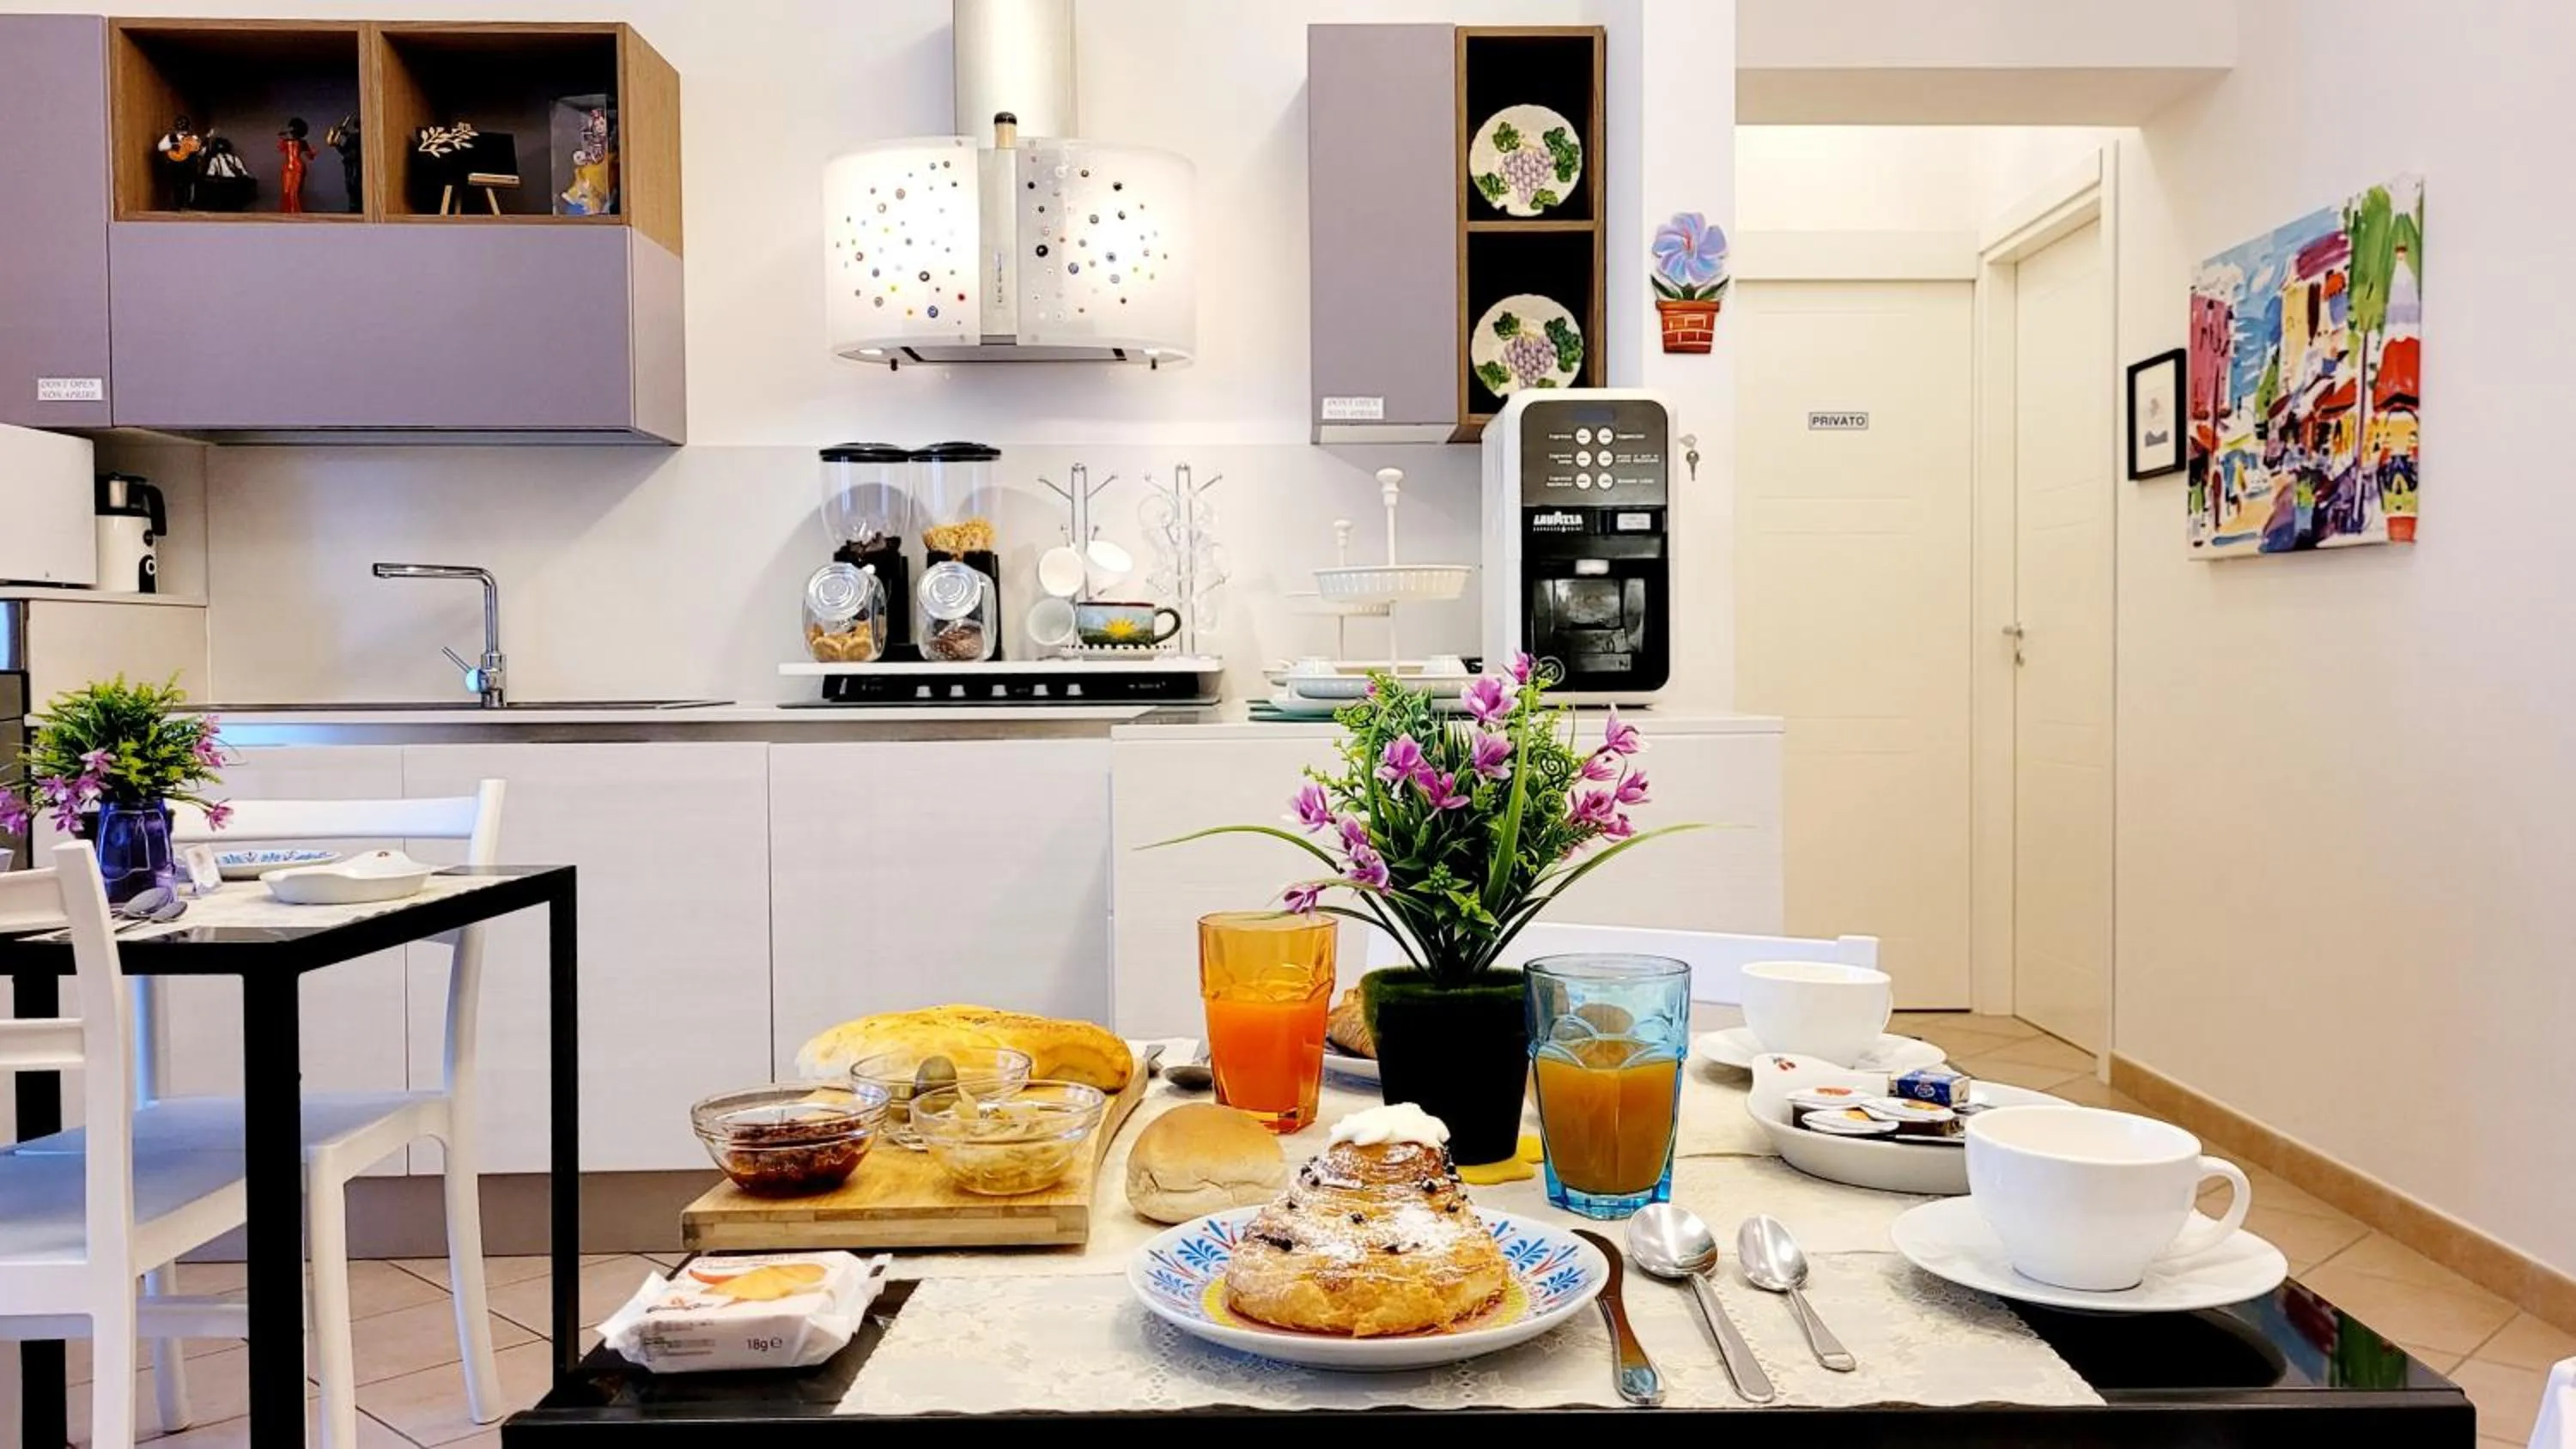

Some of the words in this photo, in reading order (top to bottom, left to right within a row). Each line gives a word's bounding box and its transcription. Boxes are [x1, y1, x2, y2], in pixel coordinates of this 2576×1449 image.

[1813, 416, 1865, 426] PRIVATO
[1534, 511, 1583, 526] LAVAZZA
[747, 1338, 769, 1352] 18g
